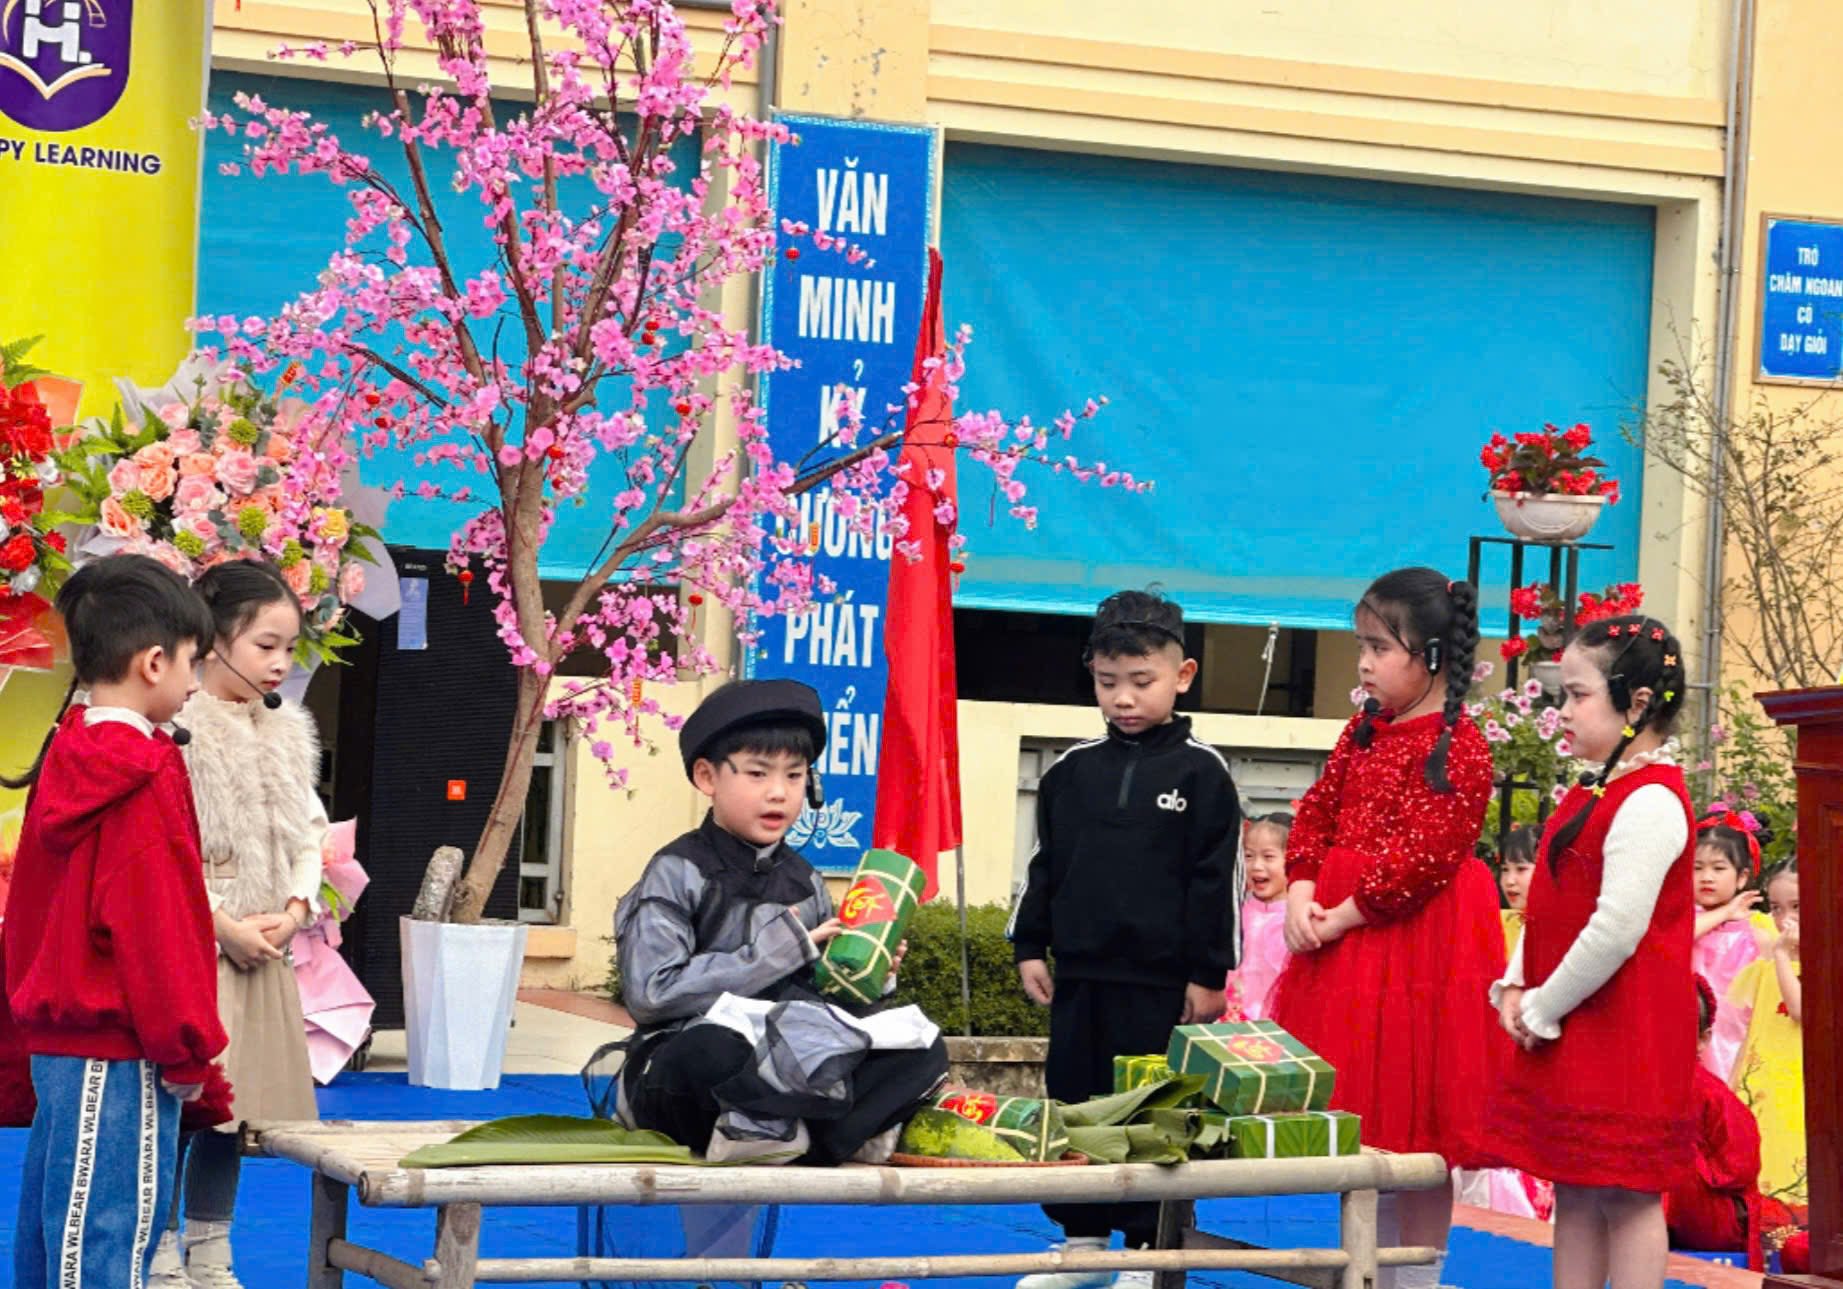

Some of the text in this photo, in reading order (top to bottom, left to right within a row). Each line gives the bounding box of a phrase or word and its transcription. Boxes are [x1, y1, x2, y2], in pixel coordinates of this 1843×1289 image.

[35, 142, 161, 174] LEARNING
[816, 156, 888, 236] VĂN
[798, 274, 895, 344] MINH
[784, 590, 879, 668] PHÁT
